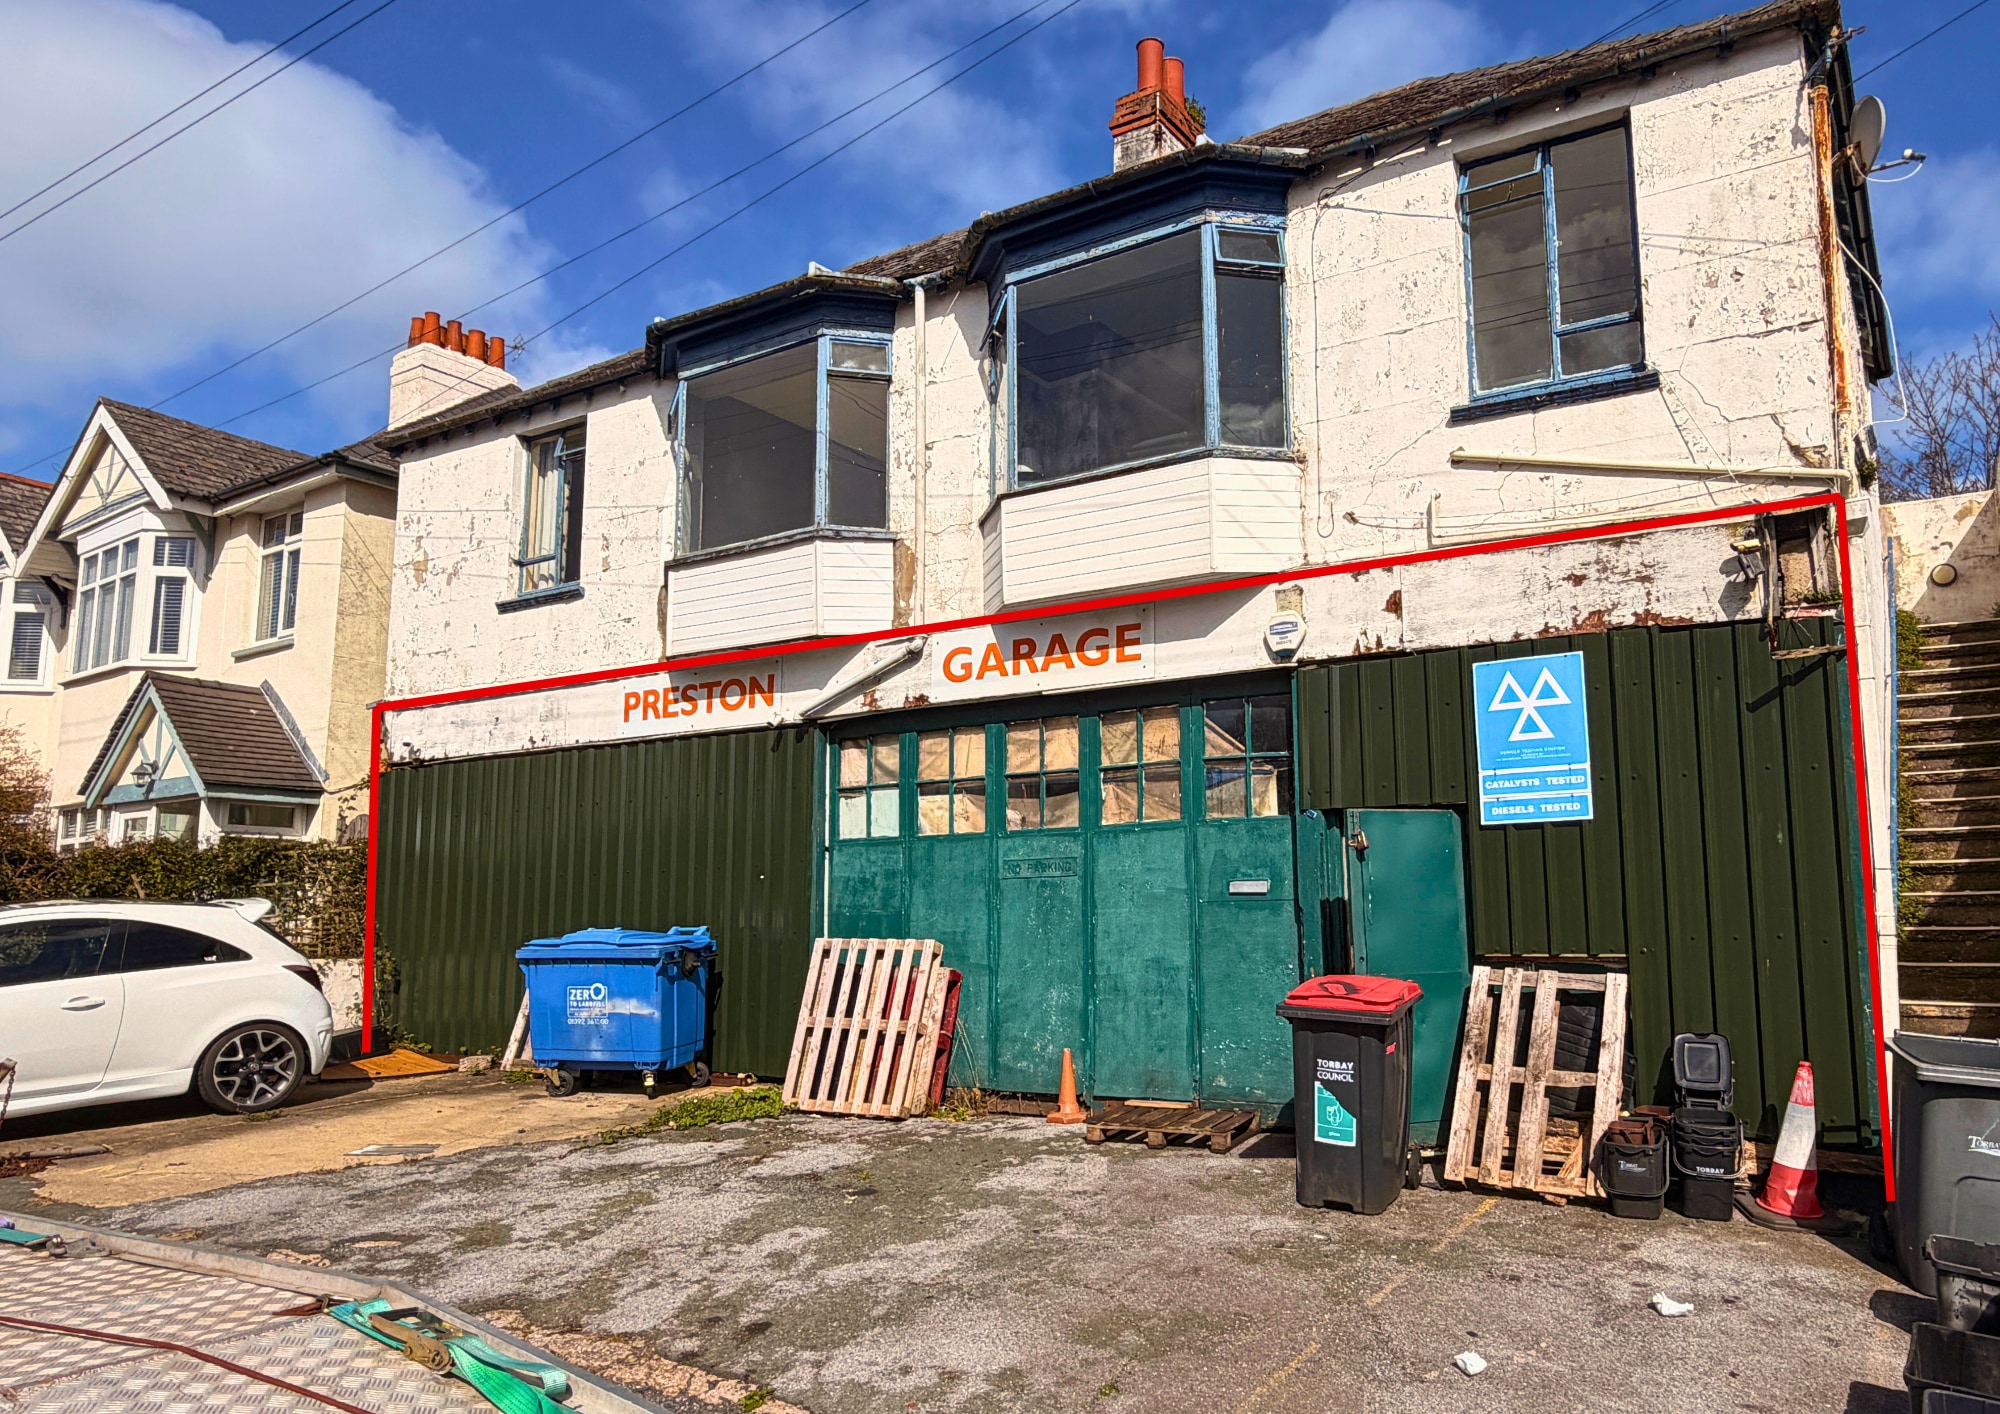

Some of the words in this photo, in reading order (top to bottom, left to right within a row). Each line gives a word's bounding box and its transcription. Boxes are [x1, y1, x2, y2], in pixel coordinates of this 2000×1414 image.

[623, 674, 775, 723] PRESTON
[943, 623, 1142, 682] GARAGE
[1485, 778, 1540, 789] CATALYSTS
[1546, 775, 1585, 785] TESTED
[1492, 805, 1534, 815] DIESELS
[1540, 803, 1580, 812] TESTED
[1008, 863, 1021, 875] NO
[1027, 861, 1072, 874] PARKING
[569, 982, 605, 1000] ZERO
[1316, 1058, 1354, 1070] TORBAY
[1316, 1071, 1354, 1083] COUNCIL
[1968, 1135, 2000, 1148] TORBA
[1695, 1166, 1725, 1174] TORBAY
